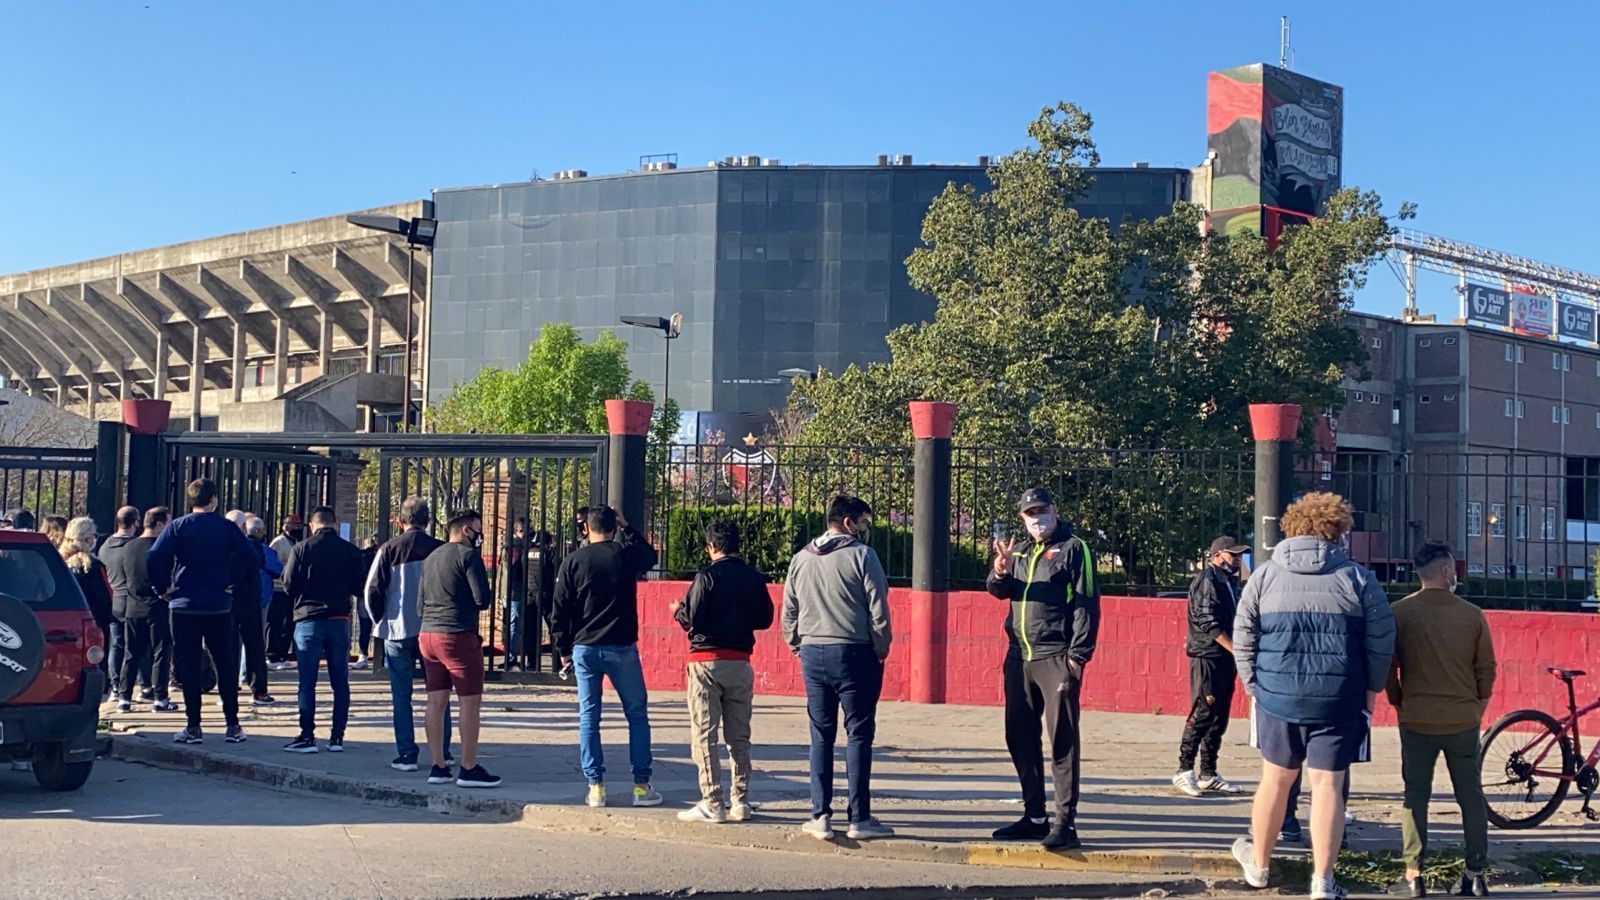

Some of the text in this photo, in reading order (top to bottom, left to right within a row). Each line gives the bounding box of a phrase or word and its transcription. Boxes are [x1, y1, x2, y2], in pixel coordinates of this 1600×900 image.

[1488, 293, 1505, 306] PLUS
[1487, 304, 1502, 315] ART
[1577, 310, 1592, 322] PLUS
[1576, 321, 1588, 332] ART
[0, 652, 28, 673] ORT
